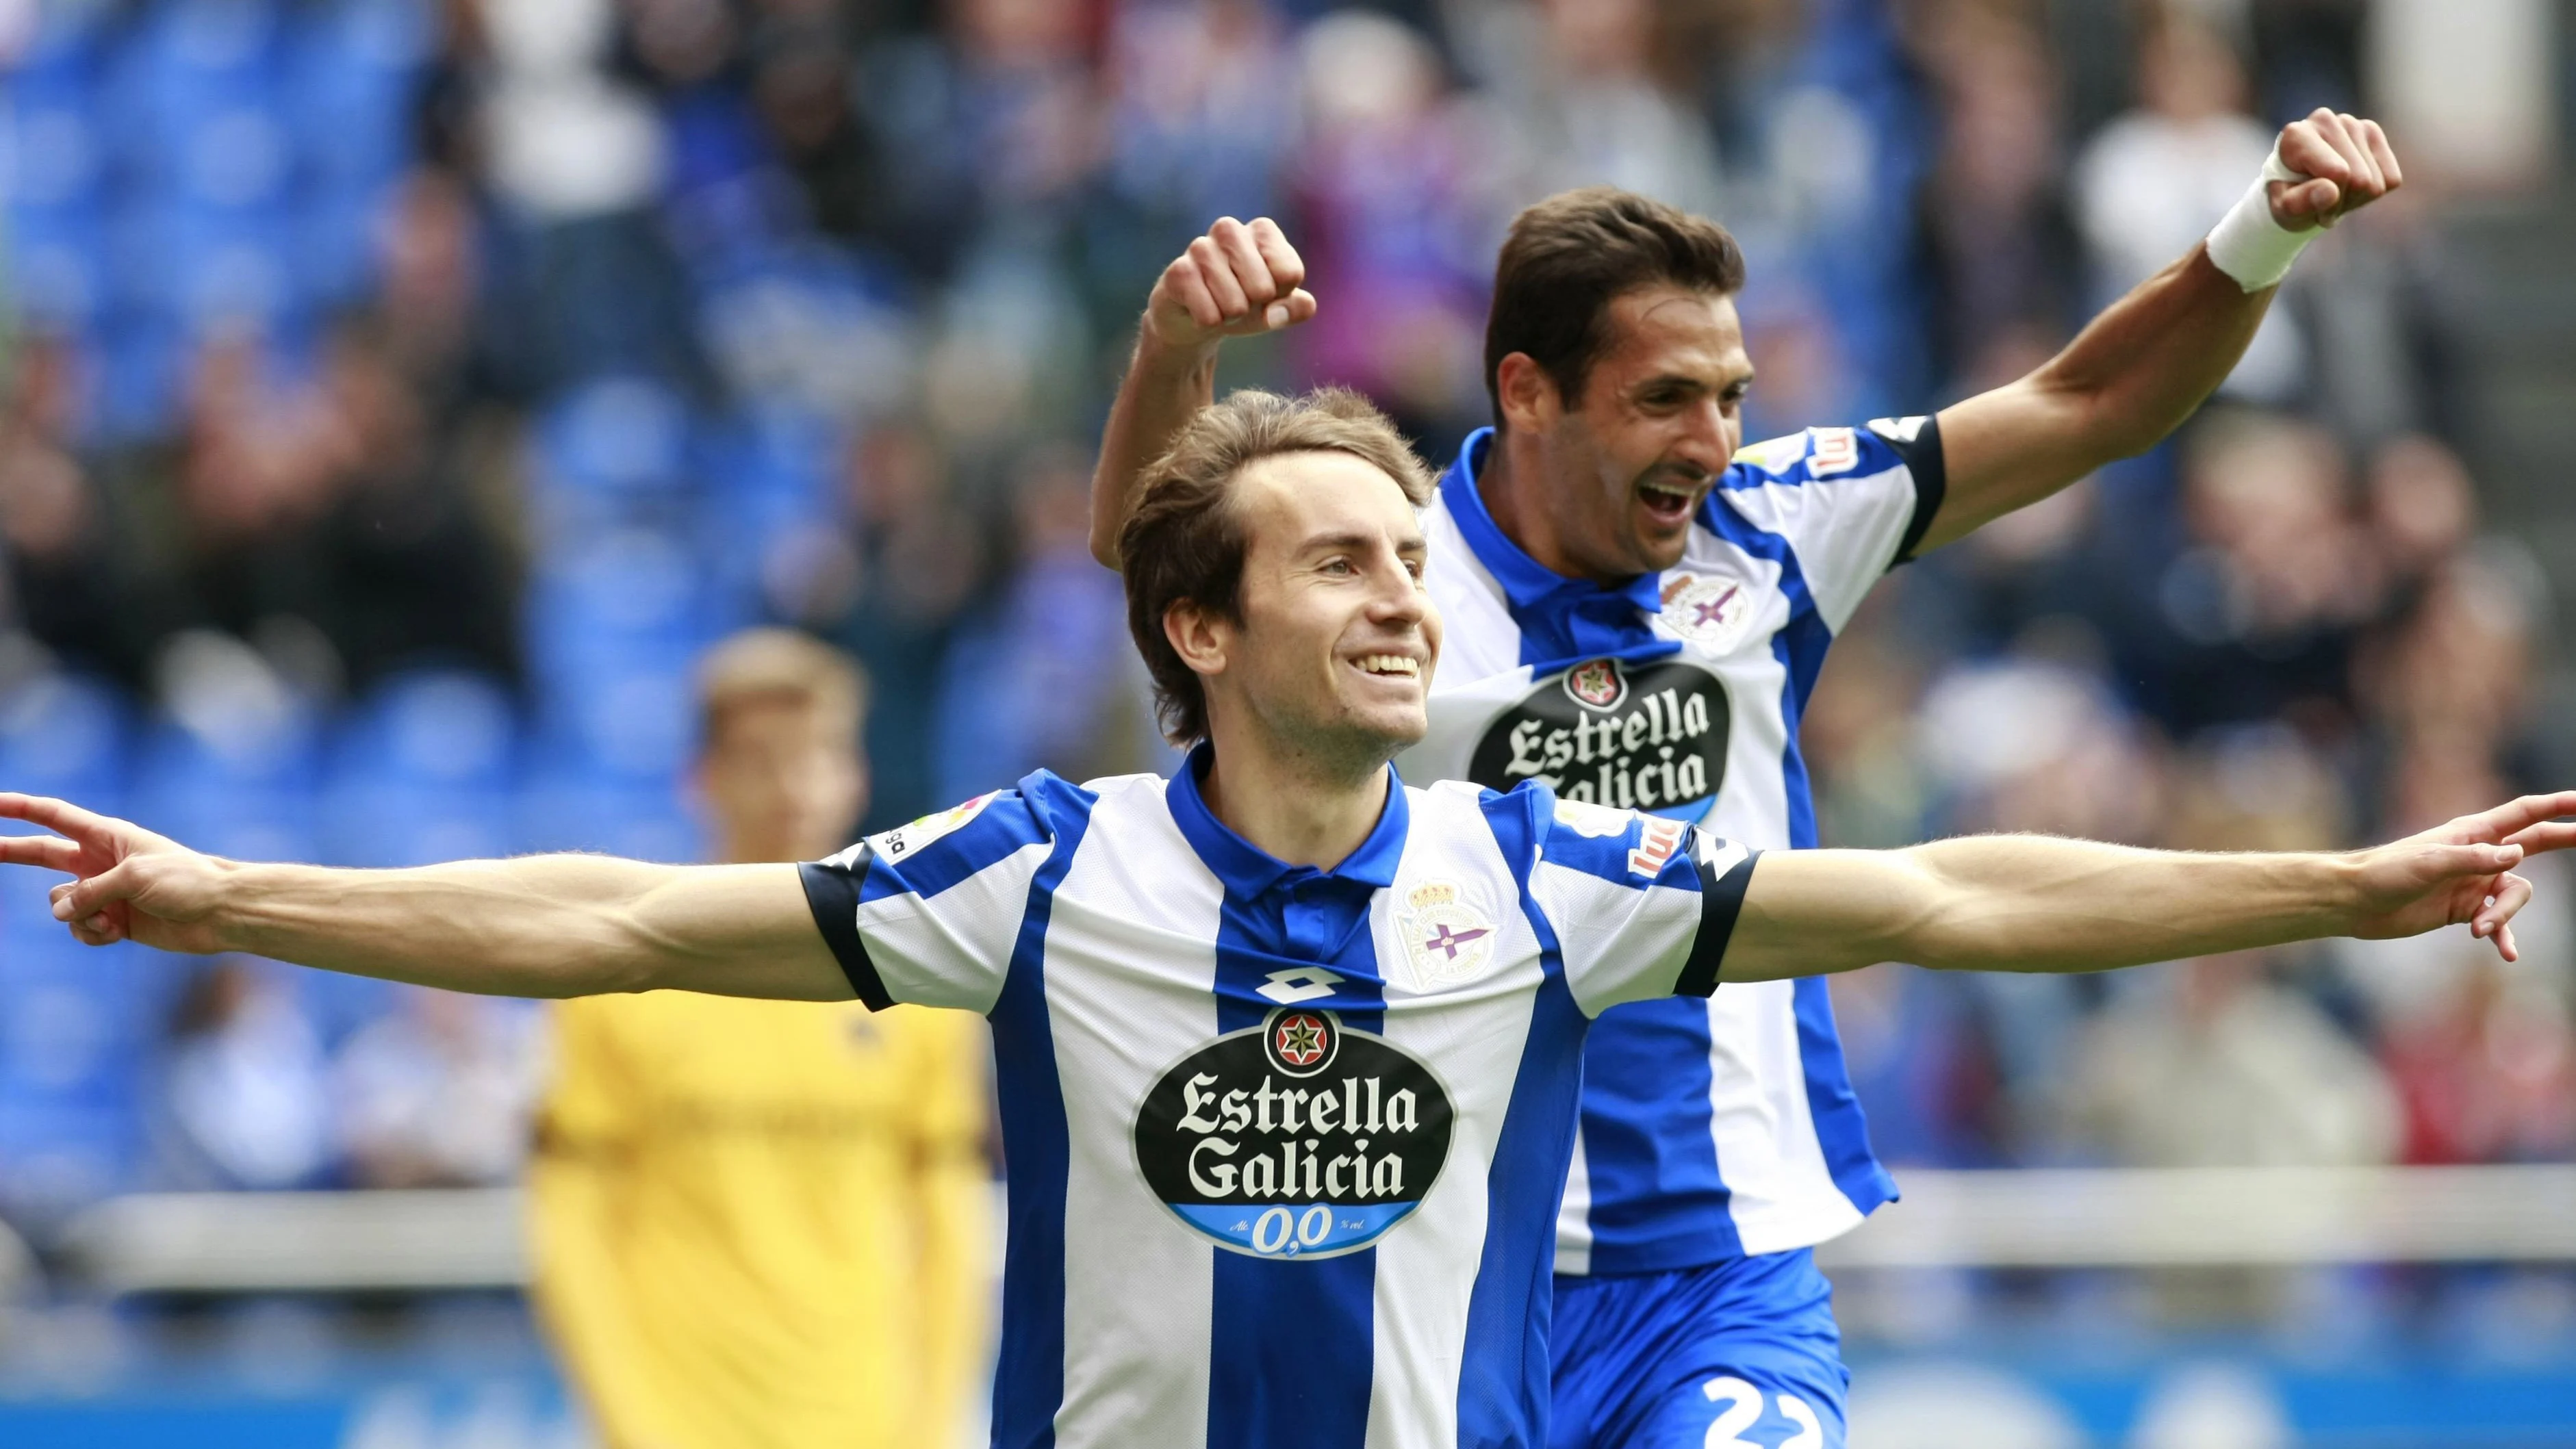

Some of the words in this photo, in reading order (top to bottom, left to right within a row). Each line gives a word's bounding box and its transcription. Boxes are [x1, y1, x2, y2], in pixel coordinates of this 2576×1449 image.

[1504, 687, 1710, 776] Estrella
[1531, 745, 1708, 809] alicia
[1176, 1071, 1419, 1135] Estrella
[1188, 1136, 1405, 1198] Galicia
[1252, 1205, 1332, 1255] 0,0
